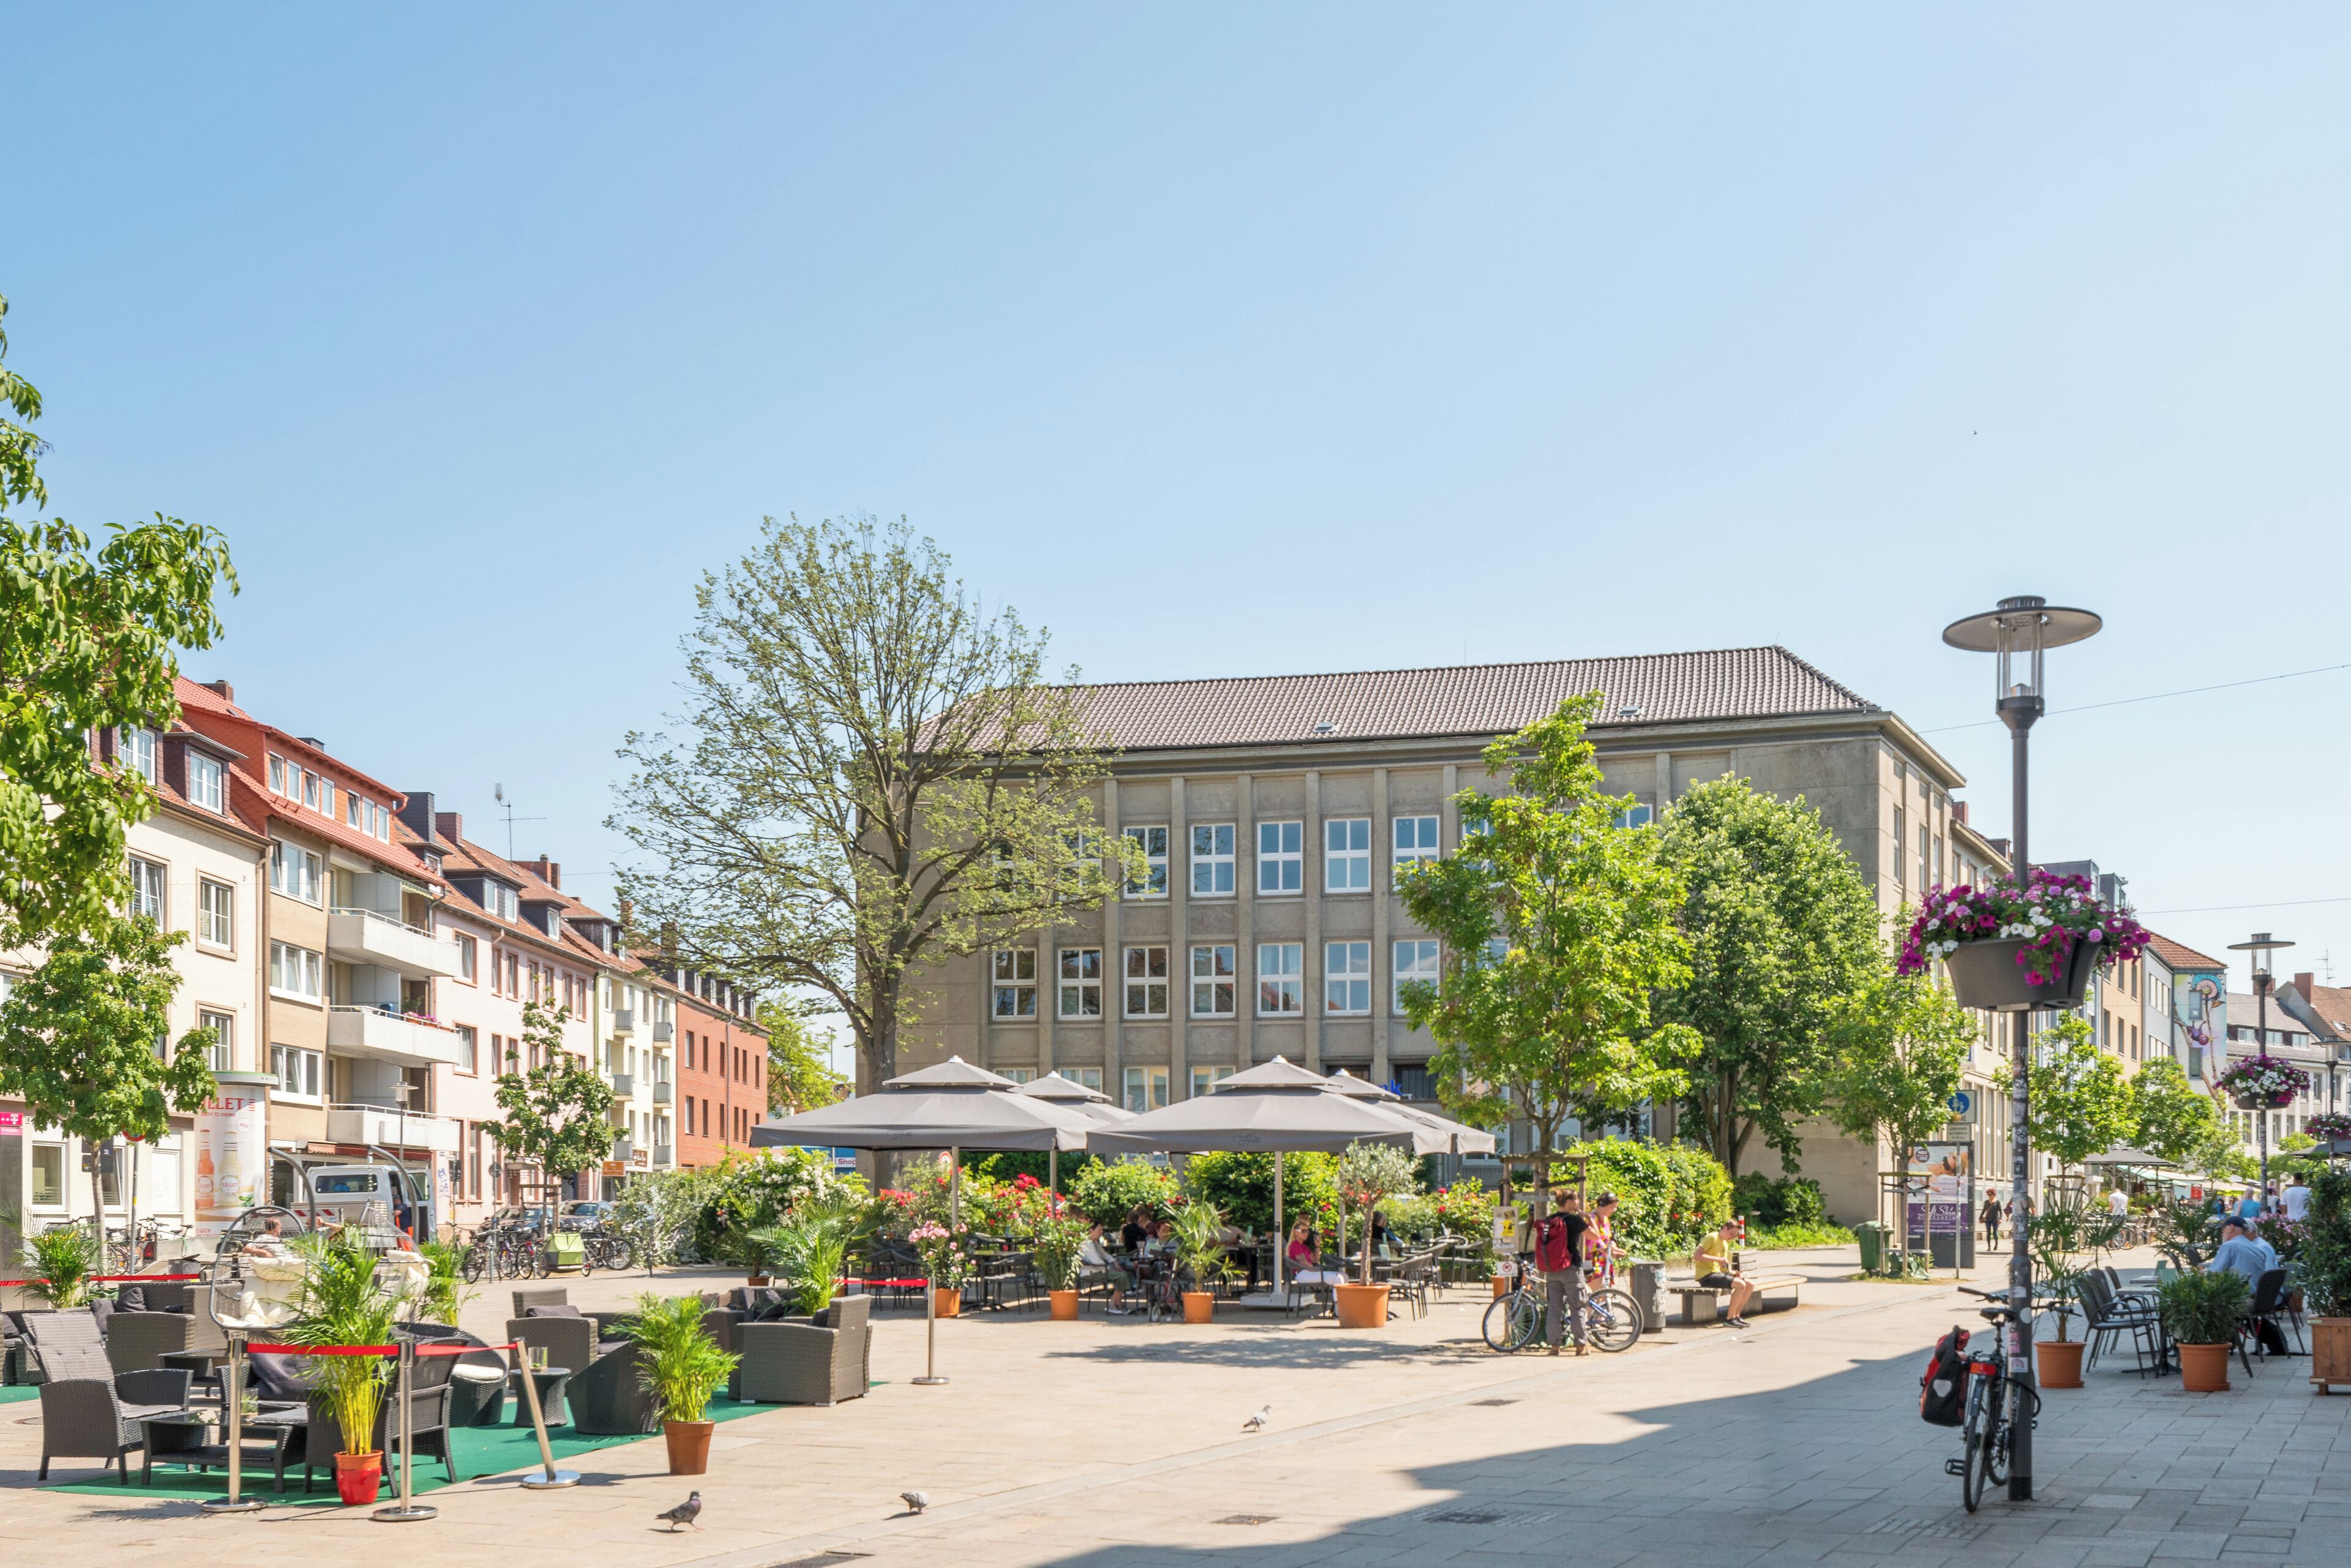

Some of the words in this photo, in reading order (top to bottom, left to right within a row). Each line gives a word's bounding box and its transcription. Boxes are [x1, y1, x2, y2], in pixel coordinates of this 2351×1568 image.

[198, 1097, 244, 1109] ILLET
[1918, 1205, 1937, 1217] Sft
[1936, 1205, 1955, 1216] Skin
